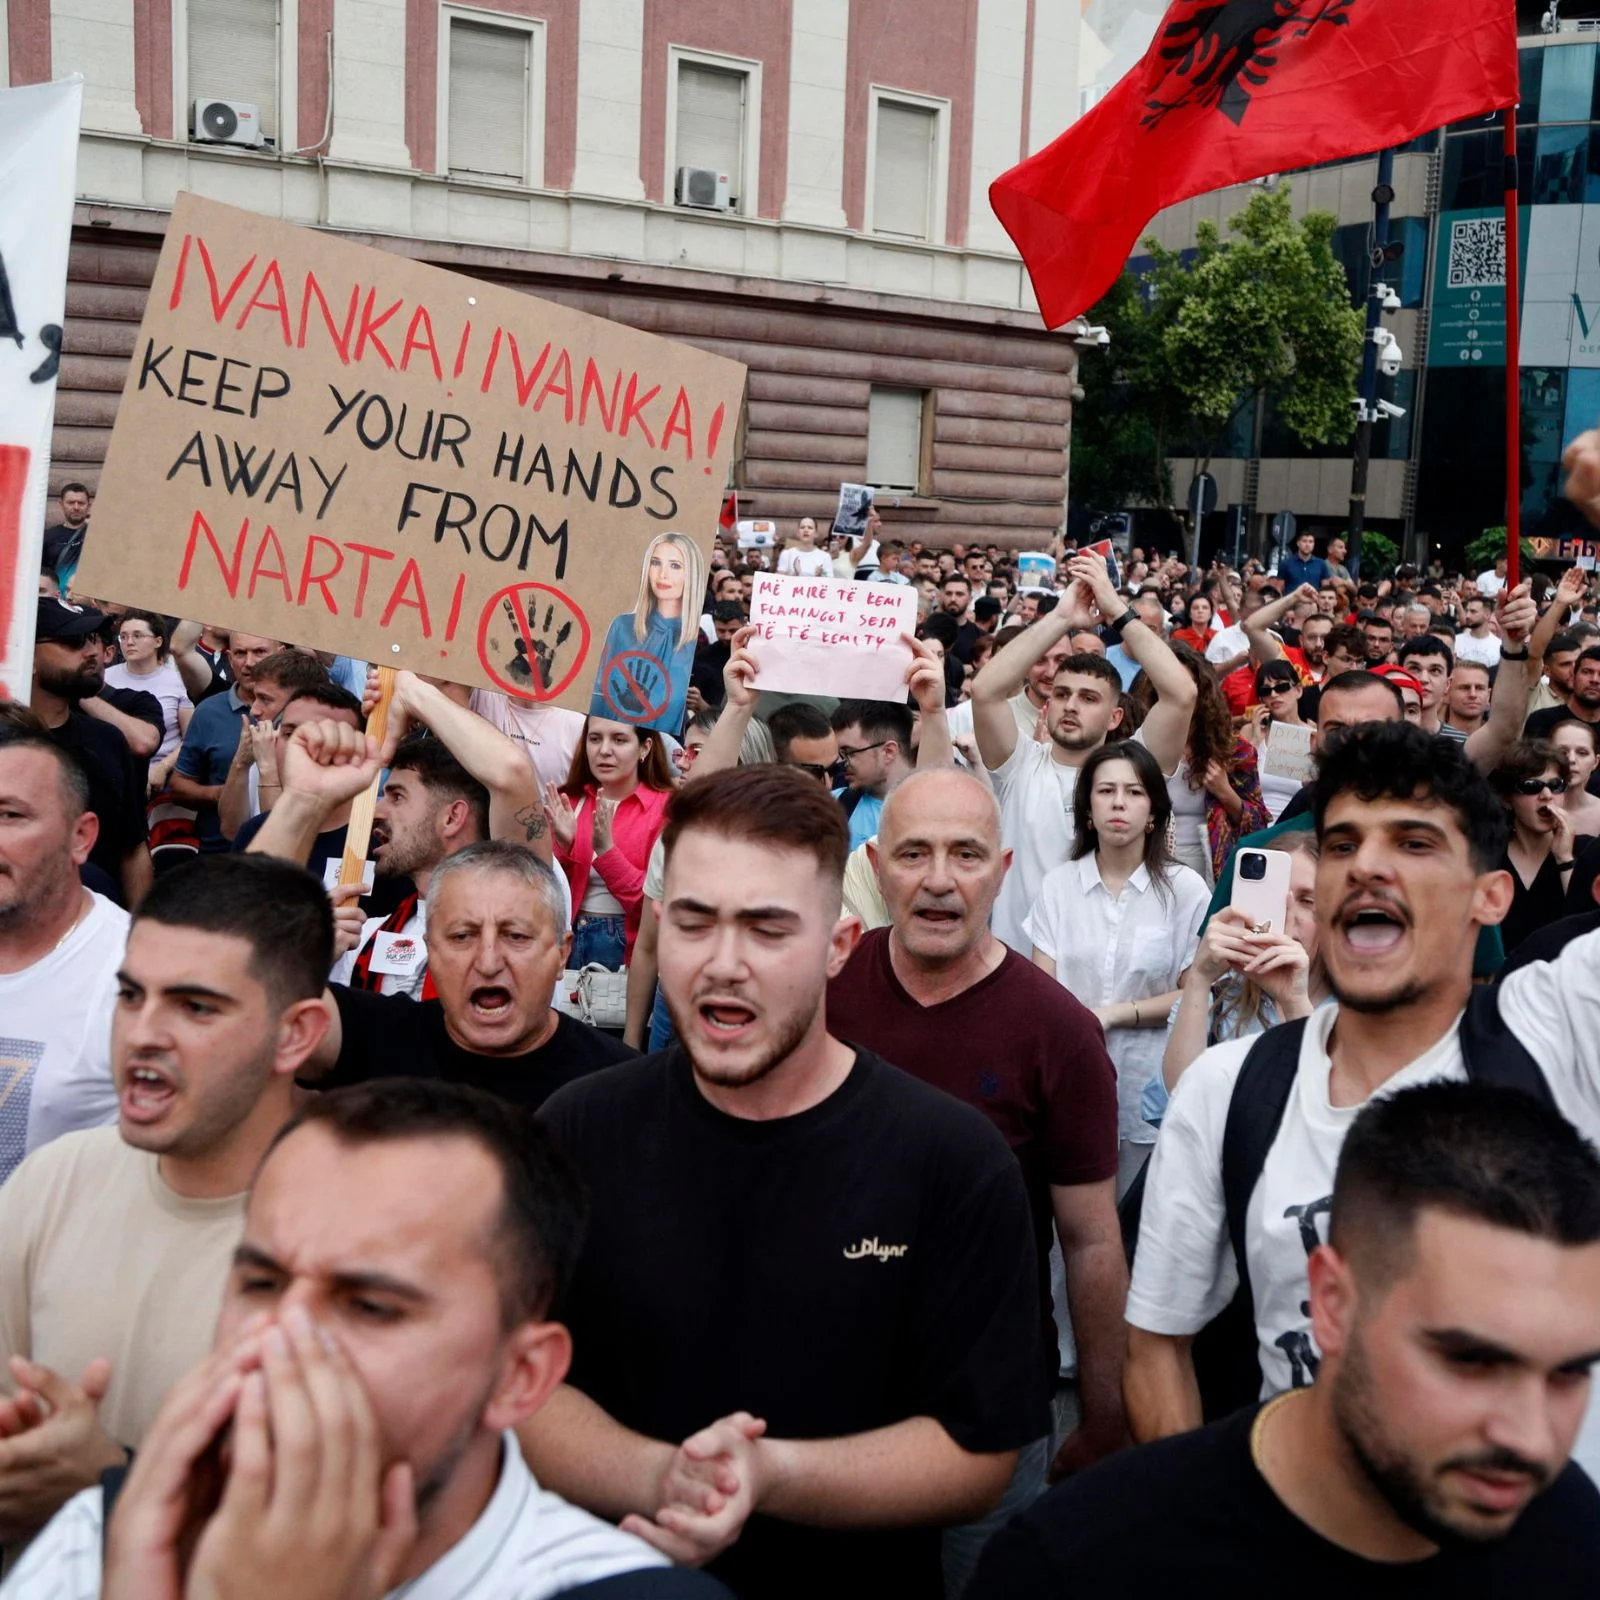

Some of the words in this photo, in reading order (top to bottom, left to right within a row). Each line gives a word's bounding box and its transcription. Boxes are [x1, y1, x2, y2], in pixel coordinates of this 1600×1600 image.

[138, 338, 291, 419] KEEP
[324, 384, 471, 468] YOUR
[493, 431, 678, 520] HANDS
[169, 236, 471, 399] IVANKA!
[480, 327, 726, 475] IVANKA!
[167, 431, 347, 520] AWAY
[397, 482, 569, 580] FROM
[177, 510, 466, 657] NARTA!
[756, 620, 776, 640] TË
[788, 624, 811, 640] TË
[759, 579, 785, 596] MË
[792, 584, 829, 599] MIRË
[837, 587, 858, 602] TË
[867, 592, 902, 608] KEMI
[859, 614, 897, 628] SESA
